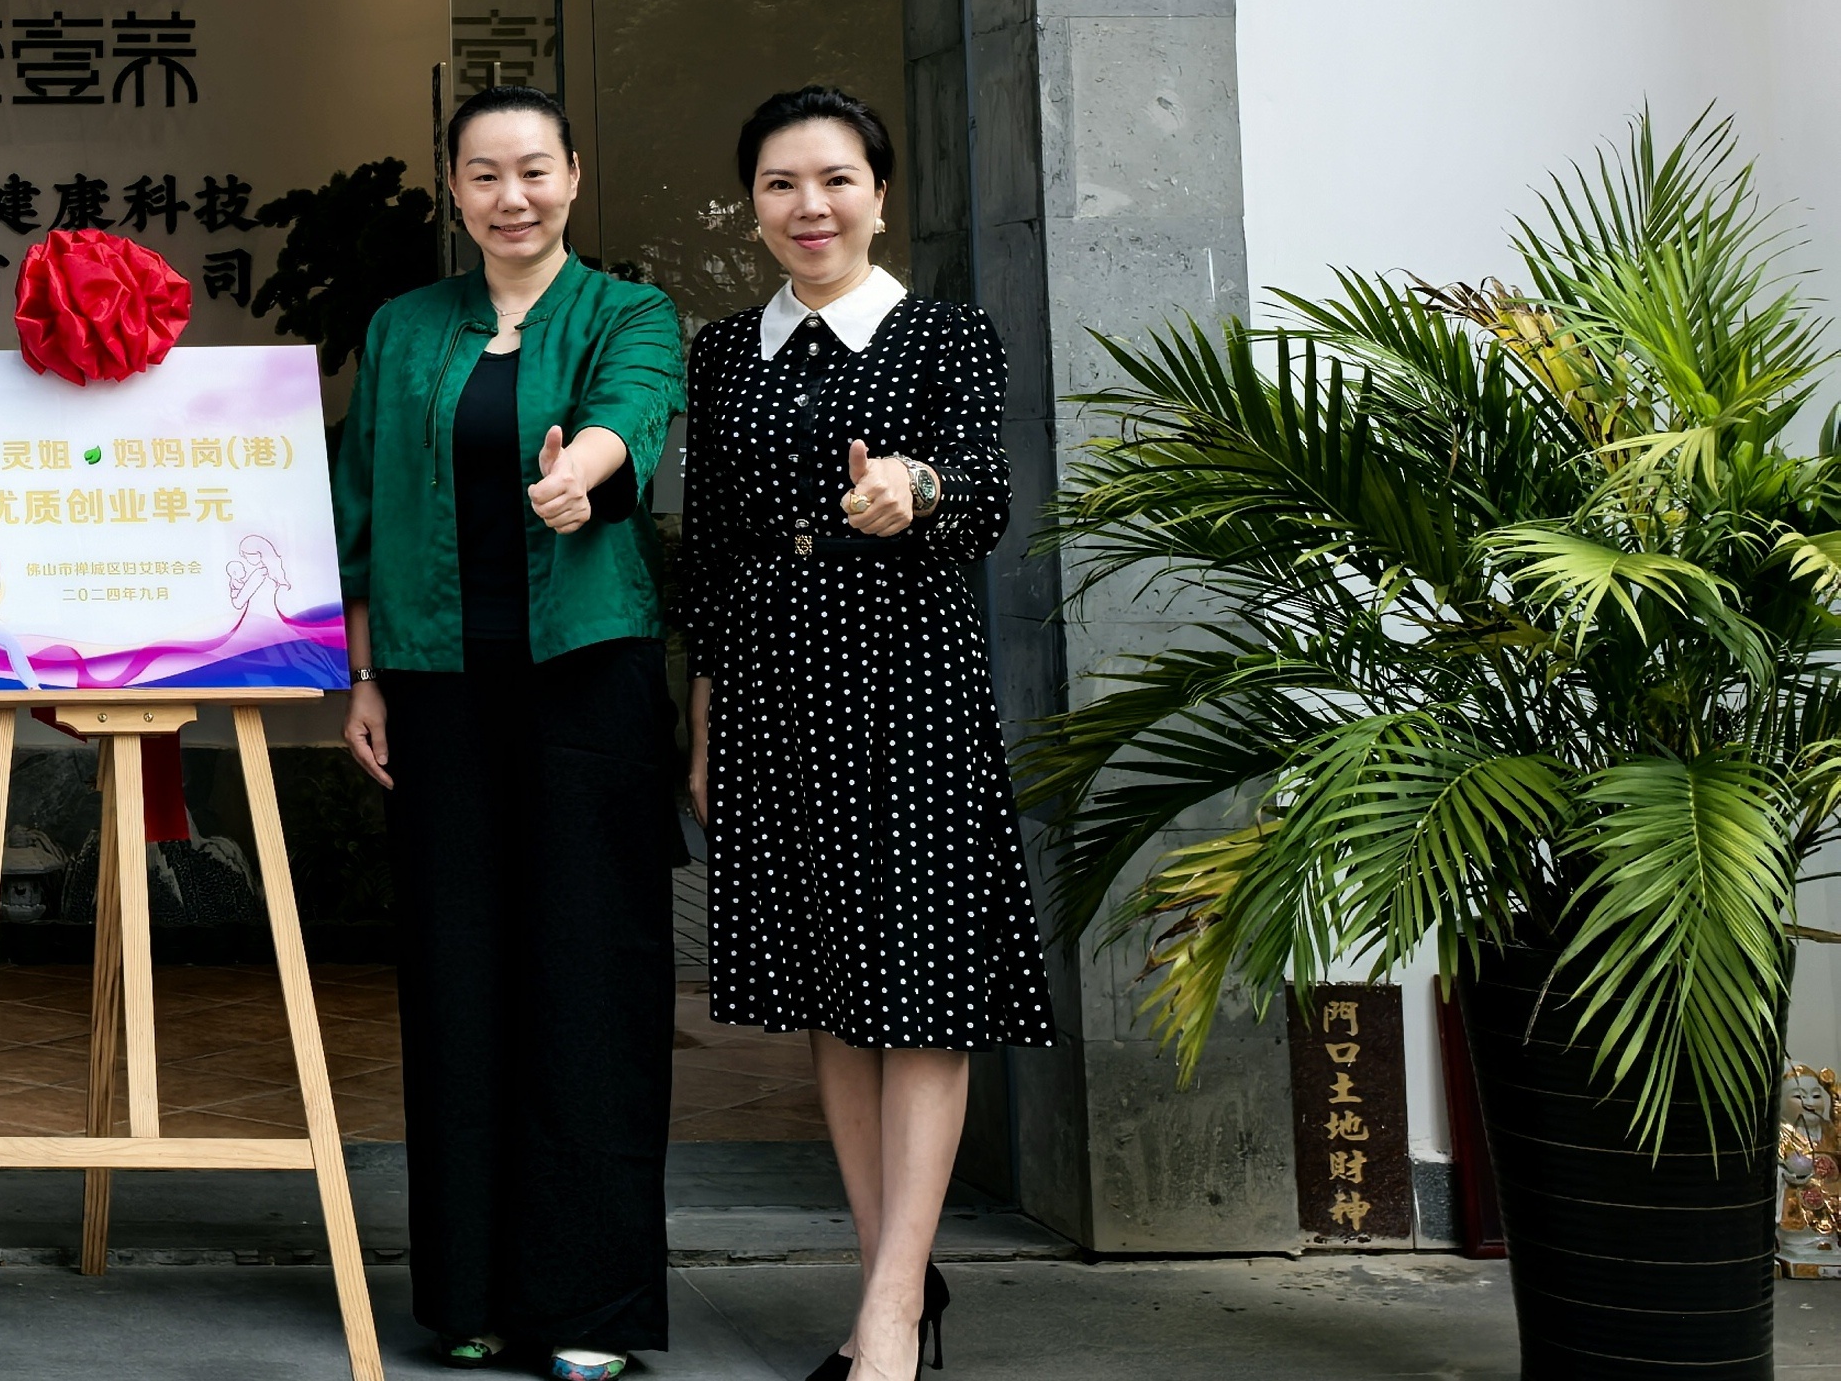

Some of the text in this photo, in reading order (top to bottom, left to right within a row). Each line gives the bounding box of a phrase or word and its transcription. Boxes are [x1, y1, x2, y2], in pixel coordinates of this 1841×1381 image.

[113, 435, 294, 470] 妈妈岗(港)
[26, 561, 202, 577] 佛山市禅城区妇女联合会
